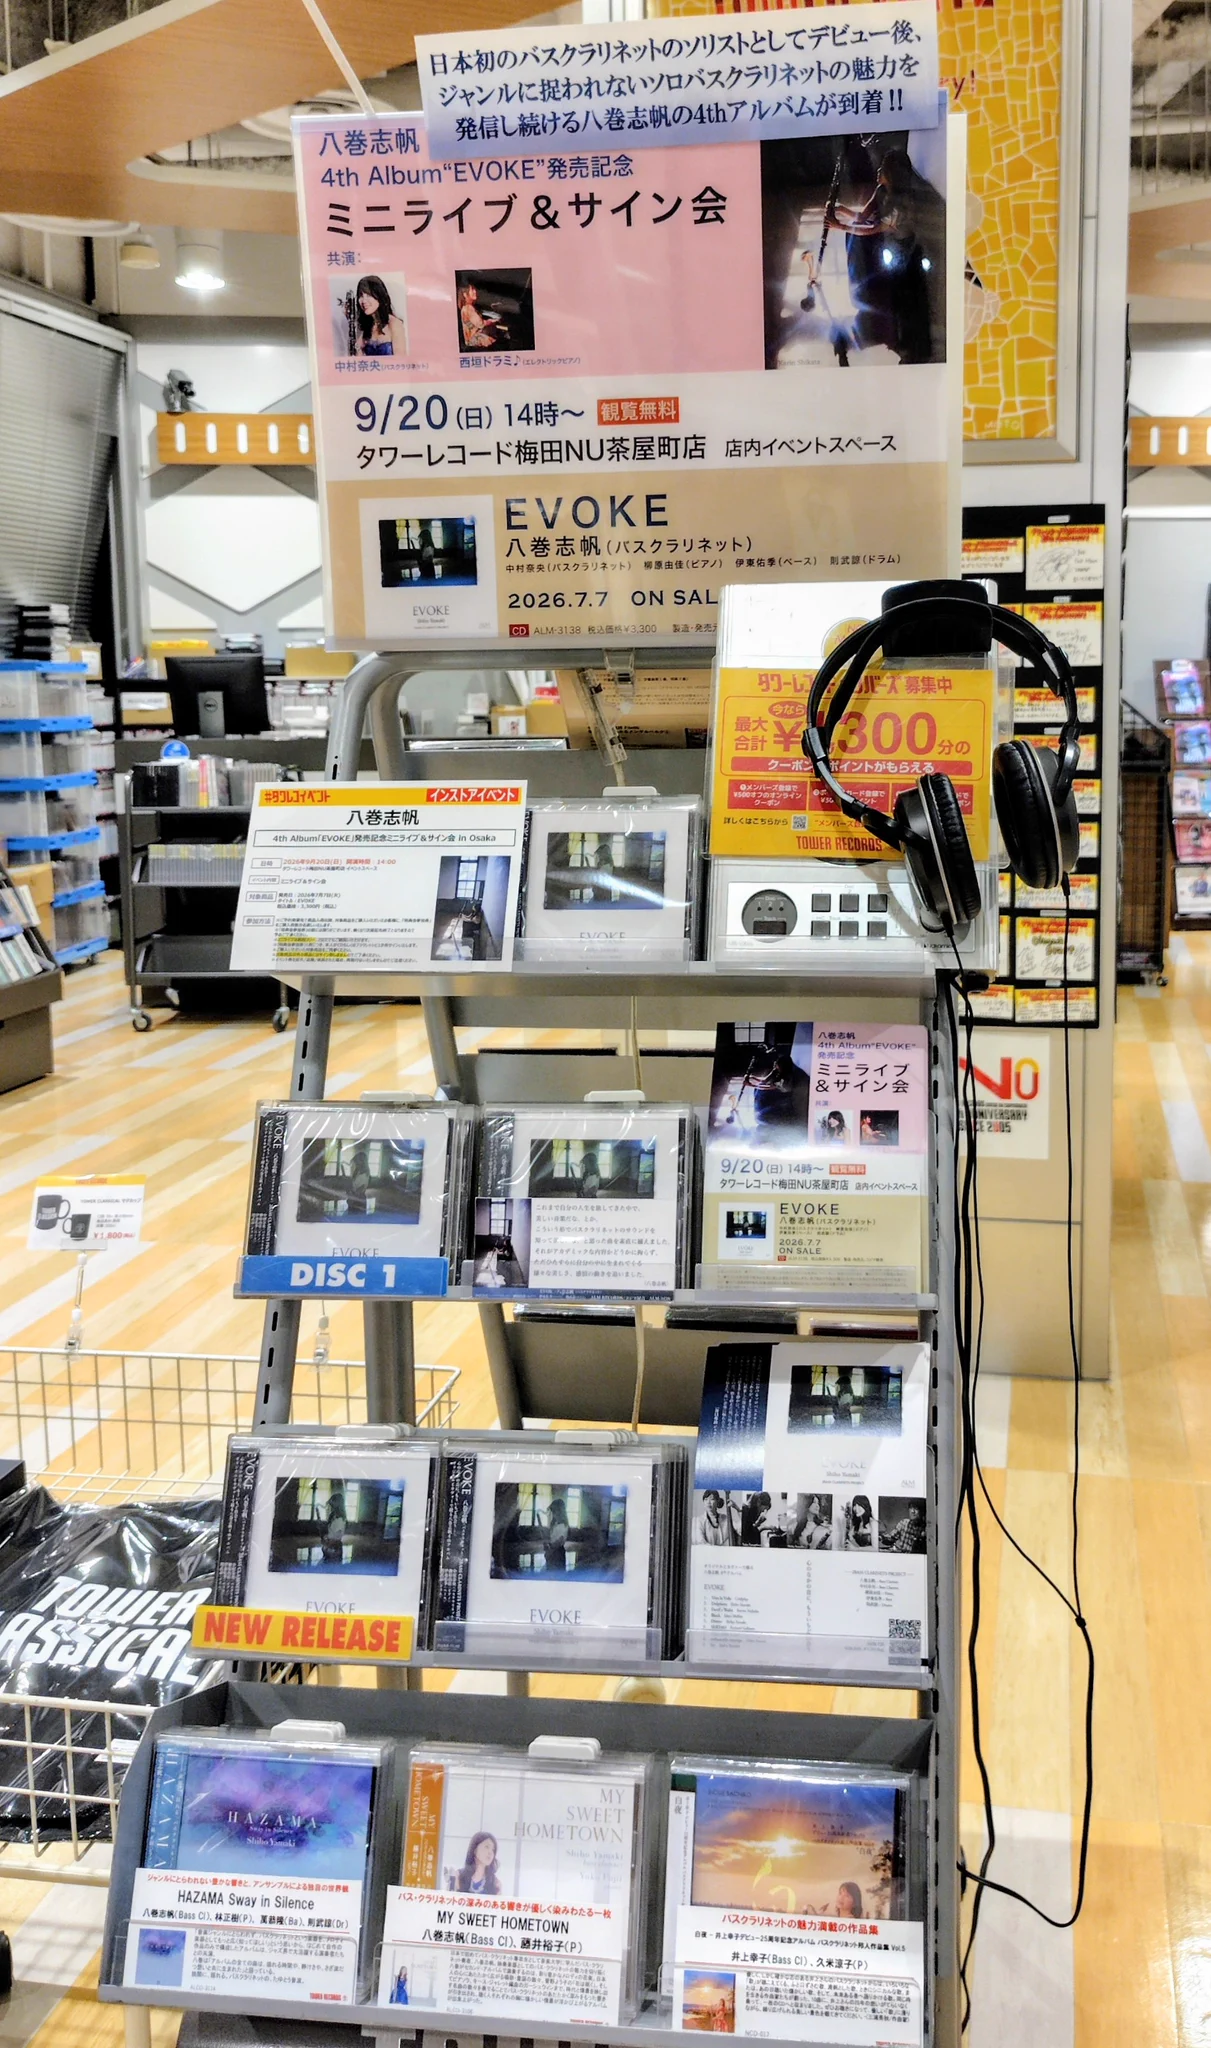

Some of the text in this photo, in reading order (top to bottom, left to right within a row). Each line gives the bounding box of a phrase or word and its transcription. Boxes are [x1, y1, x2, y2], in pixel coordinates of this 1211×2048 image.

[429, 20, 922, 76] 日本初のバスクラリネットのソリストとしてデビュー後、
[438, 55, 920, 106] ジャンルに捉われないソロバスクラリネットの魅力を
[318, 128, 420, 157] 八巻志帆
[320, 164, 360, 188] 4th
[600, 400, 677, 422] 観覧無料
[355, 434, 897, 471] タワーレコード梅田NU茶屋町店 店内イベントスペース
[506, 493, 669, 531] EVOKE
[508, 588, 718, 610] 2026.7.7 ON SAL
[412, 605, 450, 616] EVOKE
[511, 625, 527, 635] CD
[533, 624, 582, 636] ALM-3138
[904, 675, 953, 695] 募集中
[772, 703, 806, 715] 今なら
[734, 716, 768, 732] 最大
[734, 735, 767, 751] 合計
[430, 788, 516, 803] インストアイベント
[346, 809, 420, 826] 八巻志帆
[723, 816, 788, 826] 詳しくはこちらから
[272, 833, 289, 843] 4th
[469, 833, 497, 843] Osaka
[796, 836, 883, 852] TOWER RECORDS
[817, 1031, 856, 1040] 八巻志帆
[817, 1051, 855, 1060] 発売記念
[817, 1062, 910, 1078] ミニライブ
[272, 1114, 286, 1149] EVOKE
[830, 1164, 866, 1175] 観覧無料
[719, 1178, 918, 1191] タワーレコード梅田NU茶屋町店 店内イベントスペース
[779, 1203, 840, 1215] EVOKE
[779, 1238, 822, 1246] 2026.7.7
[779, 1247, 822, 1255] ON SALE
[289, 1262, 396, 1288] DISC 1
[242, 1452, 257, 1490] EVOKE
[461, 1457, 475, 1495] EVOKE
[30, 1576, 212, 1626] TOWER
[530, 1608, 582, 1624] EVOKE
[203, 1612, 401, 1654] NEW RELEASE
[0, 1611, 200, 1686] ASSICAL
[599, 1788, 625, 1805] MY
[674, 1795, 683, 1815] 白夜
[228, 1811, 316, 1829] HAZAMA
[420, 1795, 430, 1828] SWEET
[566, 1805, 626, 1824] SWEET
[428, 1814, 437, 1828] MY
[246, 1836, 296, 1847] Shiho Yamaki
[513, 1821, 624, 1844] HOMETOWN
[177, 1889, 315, 1910] HAZAMA Sway in Silence
[436, 1910, 570, 1934] MY SWEET HOMETOWN
[722, 1914, 880, 1936] バスクラリネットの魅力満載の作品集
